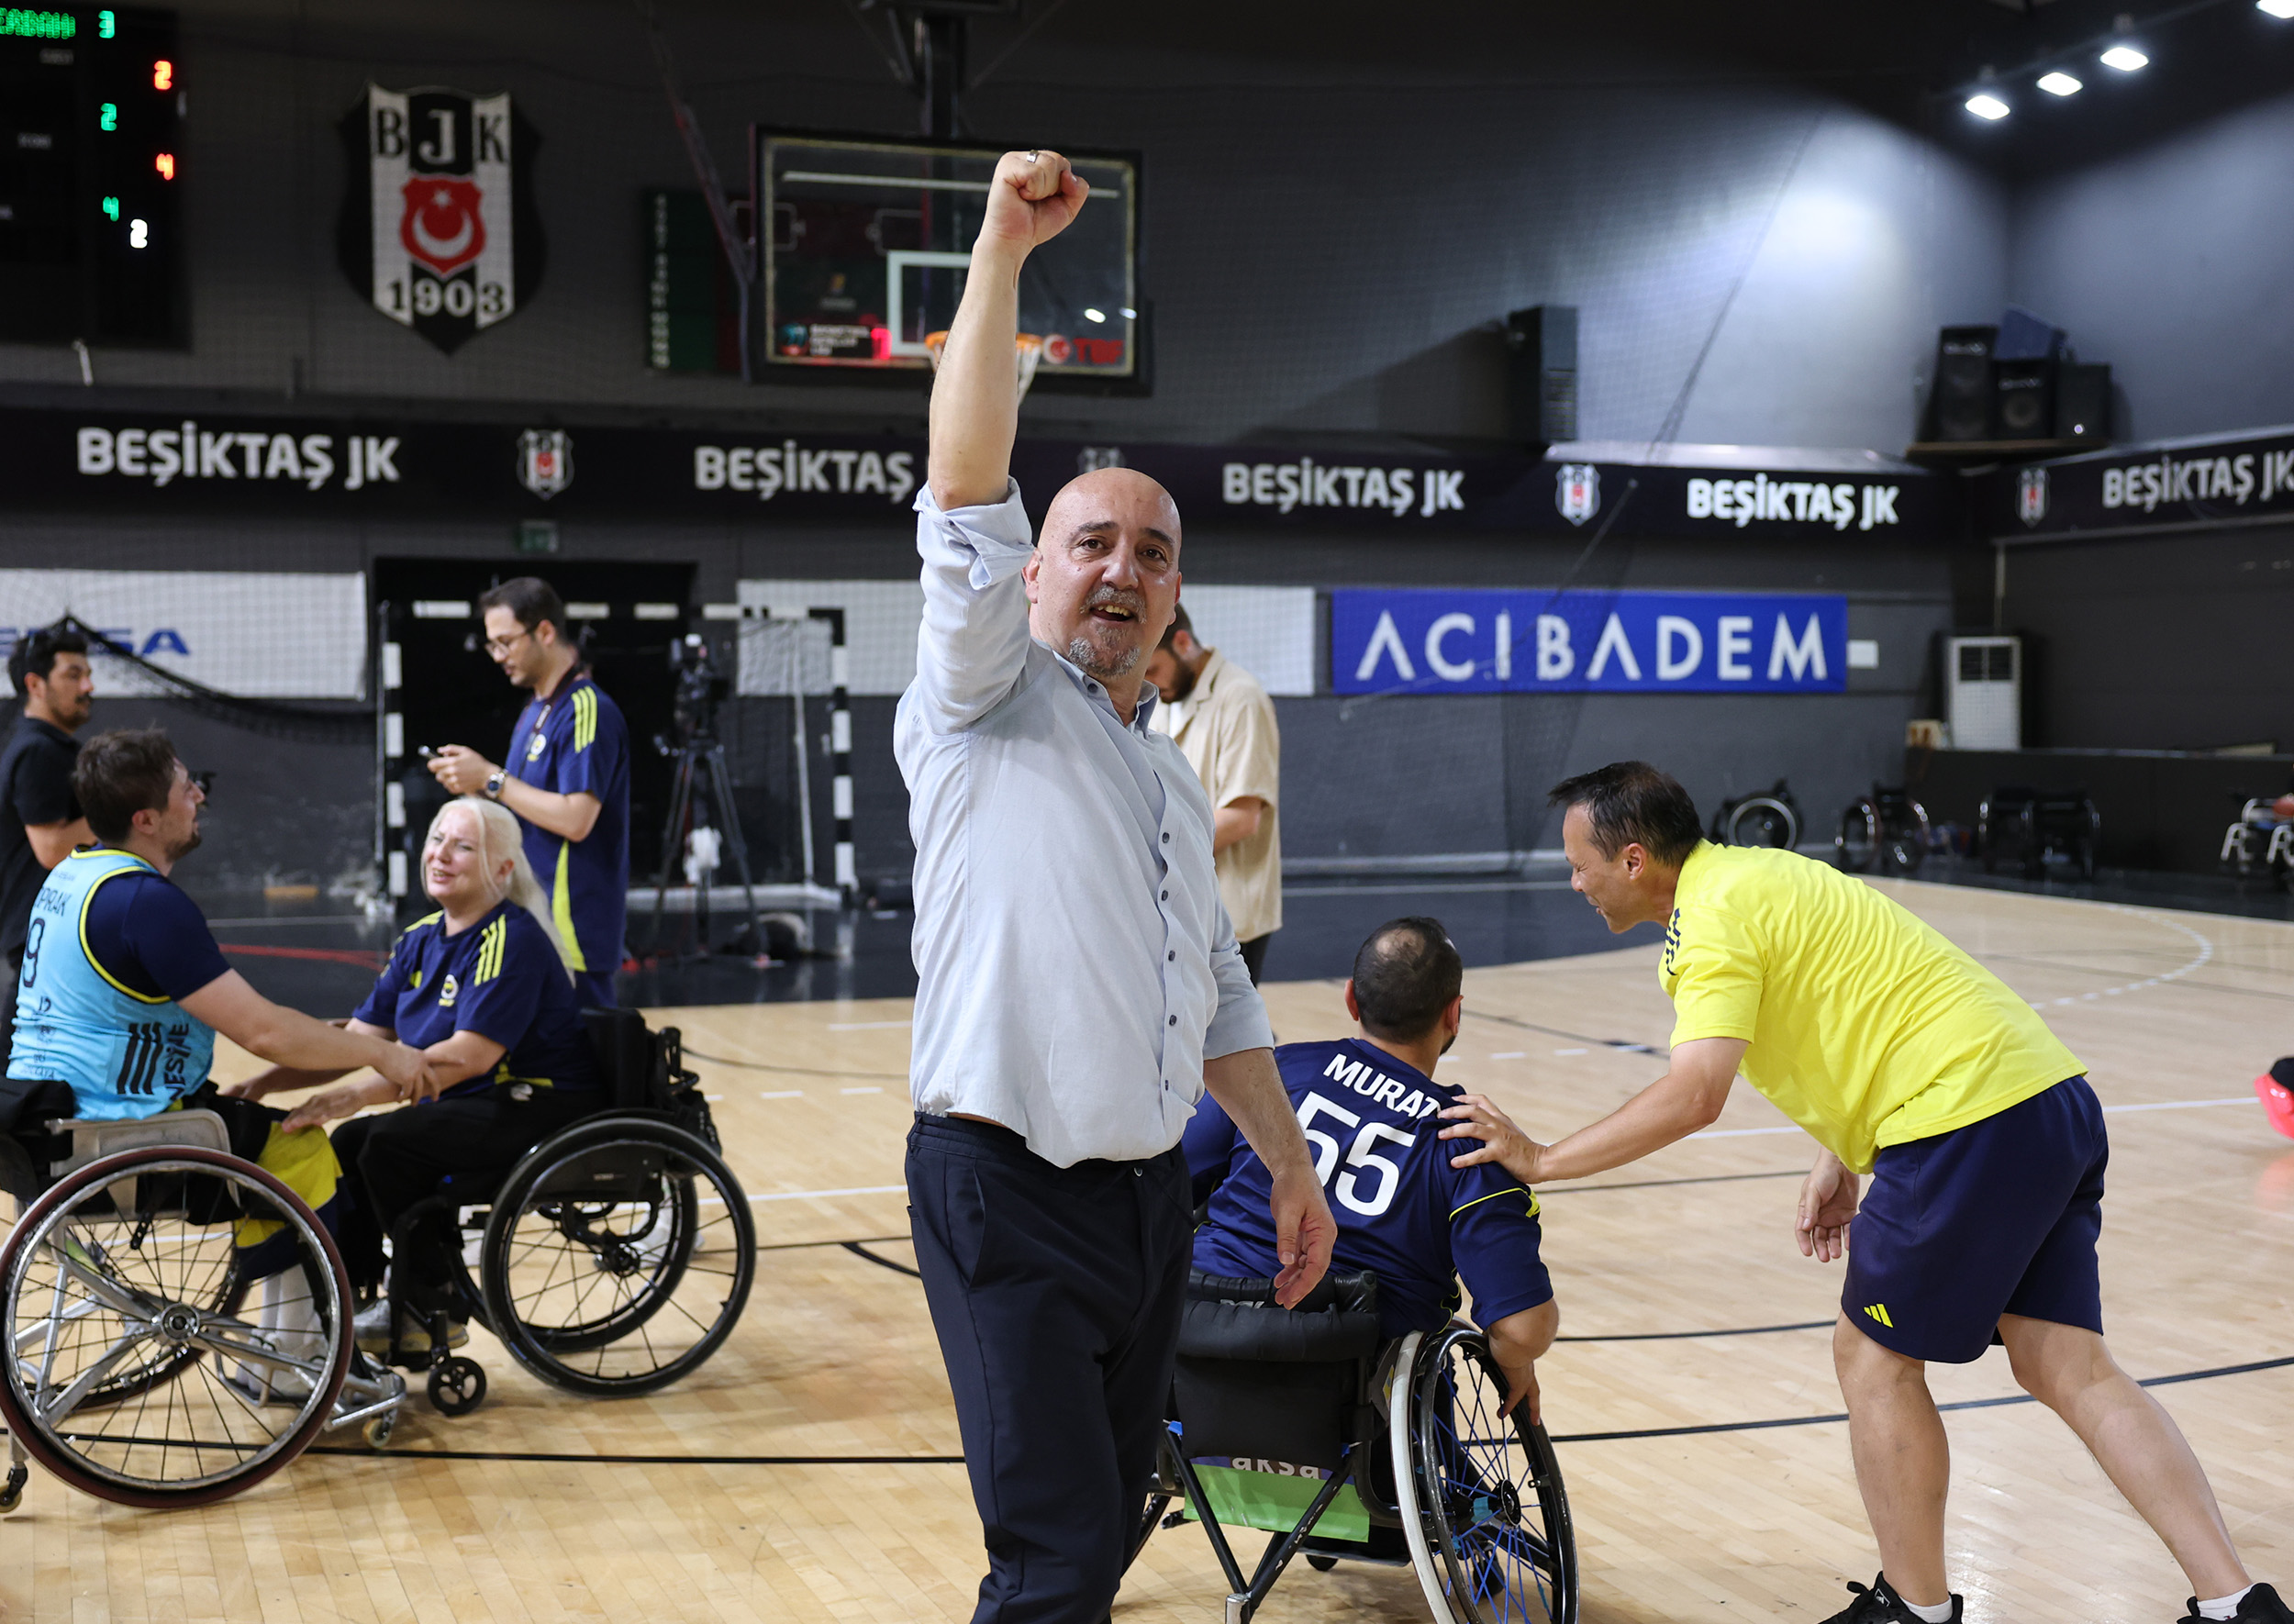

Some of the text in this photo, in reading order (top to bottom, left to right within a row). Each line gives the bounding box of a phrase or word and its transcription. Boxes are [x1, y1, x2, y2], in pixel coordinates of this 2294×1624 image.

[98, 10, 115, 39] 3
[154, 61, 172, 90] 2
[101, 103, 117, 131] 2
[377, 106, 506, 165] BJK
[156, 153, 173, 181] 4
[103, 196, 118, 221] 4
[130, 219, 148, 249] 2
[389, 277, 505, 317] 1903
[77, 420, 400, 490] BEŞİKTAŞ JK
[695, 439, 915, 504] BEŞİKTAŞ
[2102, 449, 2294, 513] BEŞİKTAŞ JK
[1222, 456, 1465, 517] BEŞİKTAŞ JK
[1687, 473, 1900, 531] BEŞİKTAŞ JK
[1355, 609, 1828, 682] ACIBADEM
[1322, 1053, 1441, 1119] MURAT
[1296, 1090, 1417, 1217] 55
